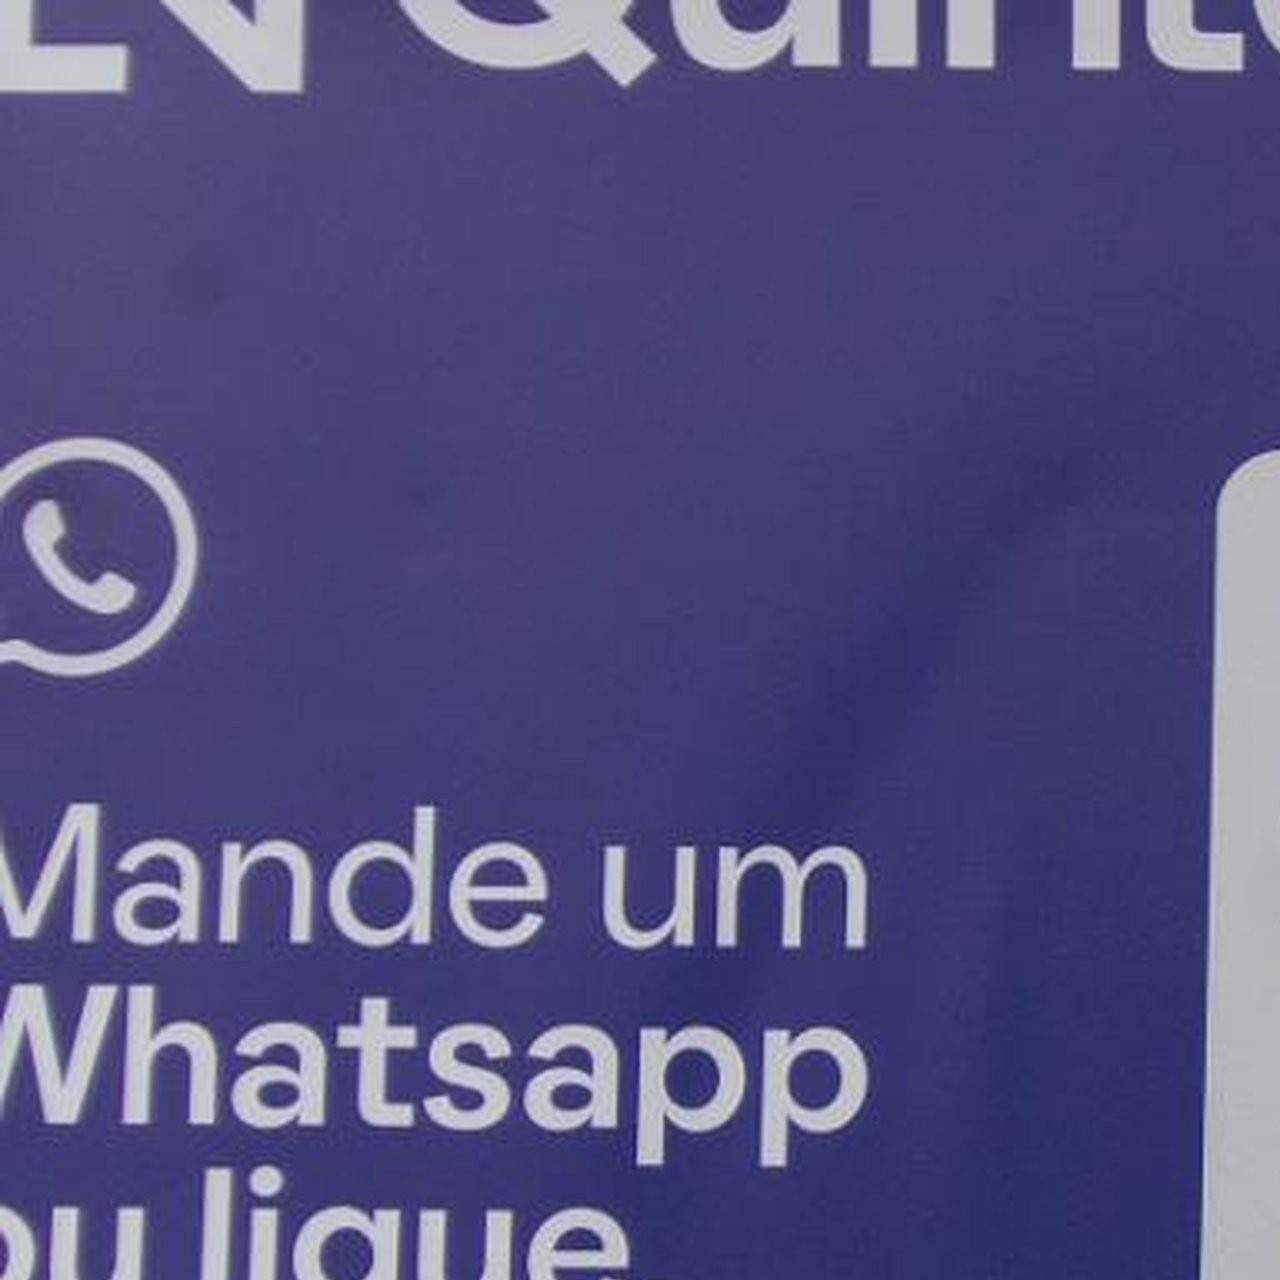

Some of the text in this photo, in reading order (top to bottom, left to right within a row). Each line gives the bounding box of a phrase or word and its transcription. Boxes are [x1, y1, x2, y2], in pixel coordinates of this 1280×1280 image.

[0, 803, 868, 949] Mande um
[0, 983, 869, 1169] Whatsapp
